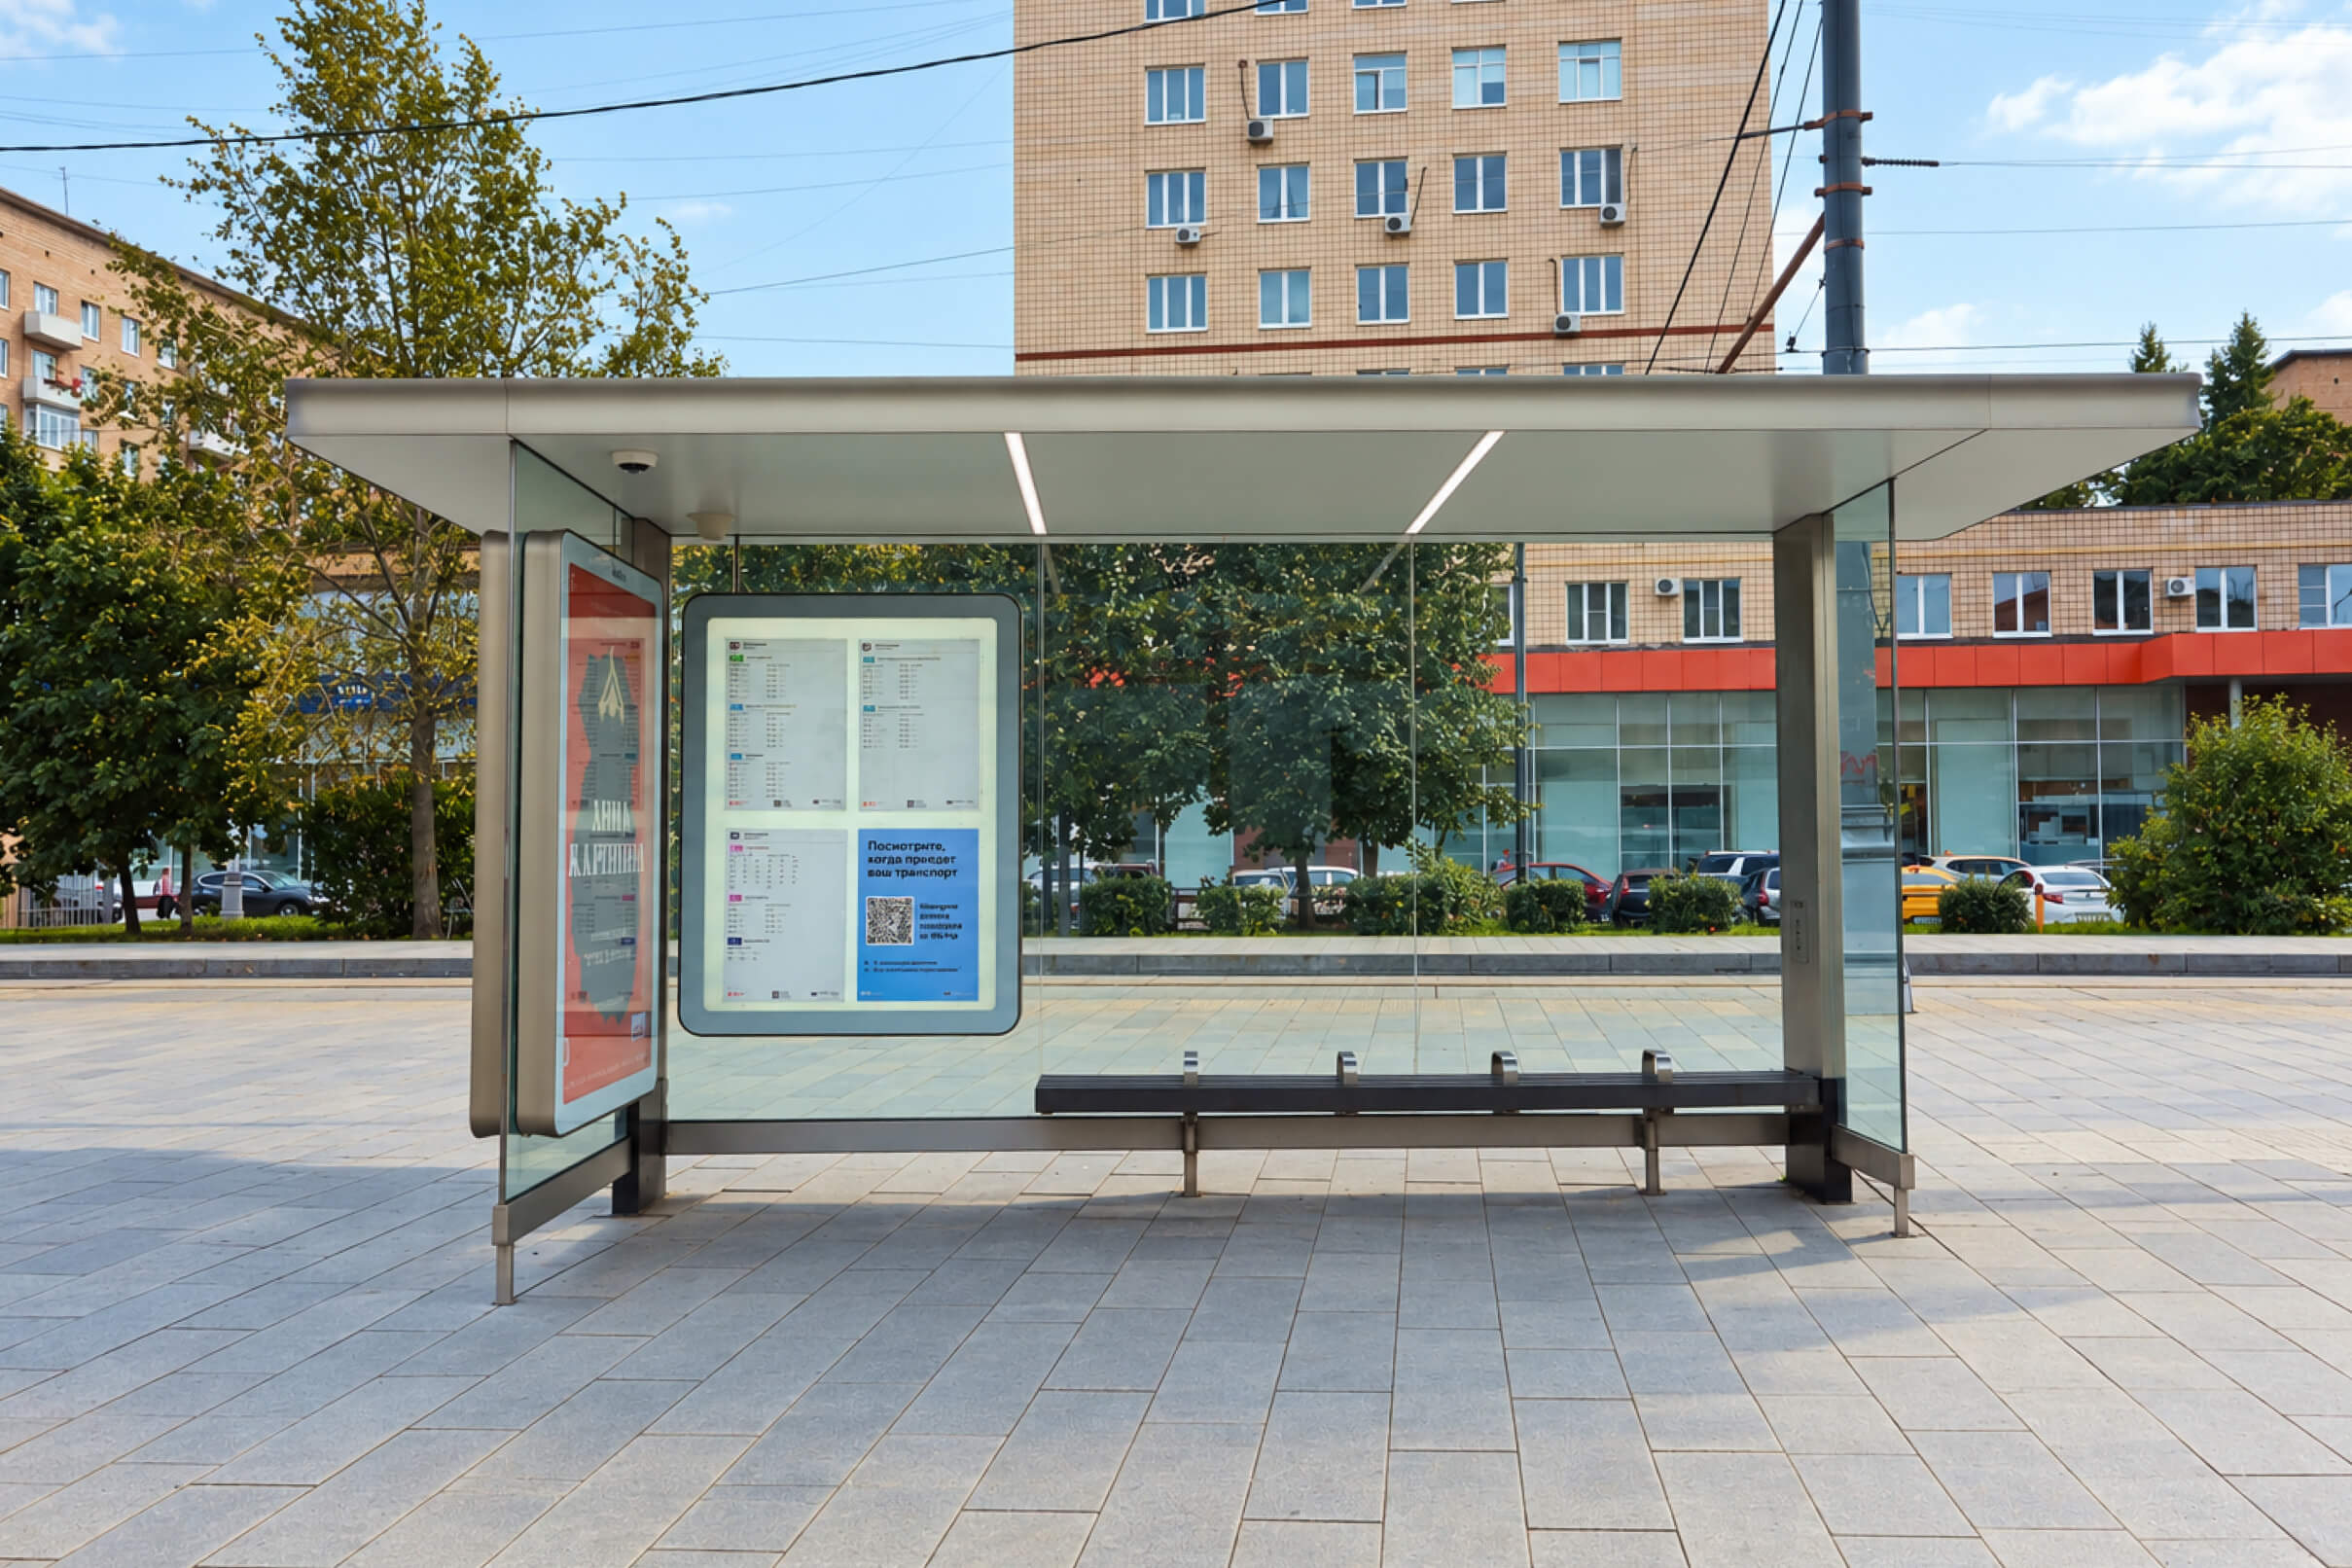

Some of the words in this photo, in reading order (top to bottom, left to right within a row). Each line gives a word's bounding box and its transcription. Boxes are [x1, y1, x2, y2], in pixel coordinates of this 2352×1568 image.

[868, 839, 946, 852] Посмотрите,
[868, 855, 903, 865] когда
[895, 869, 957, 879] транспорт
